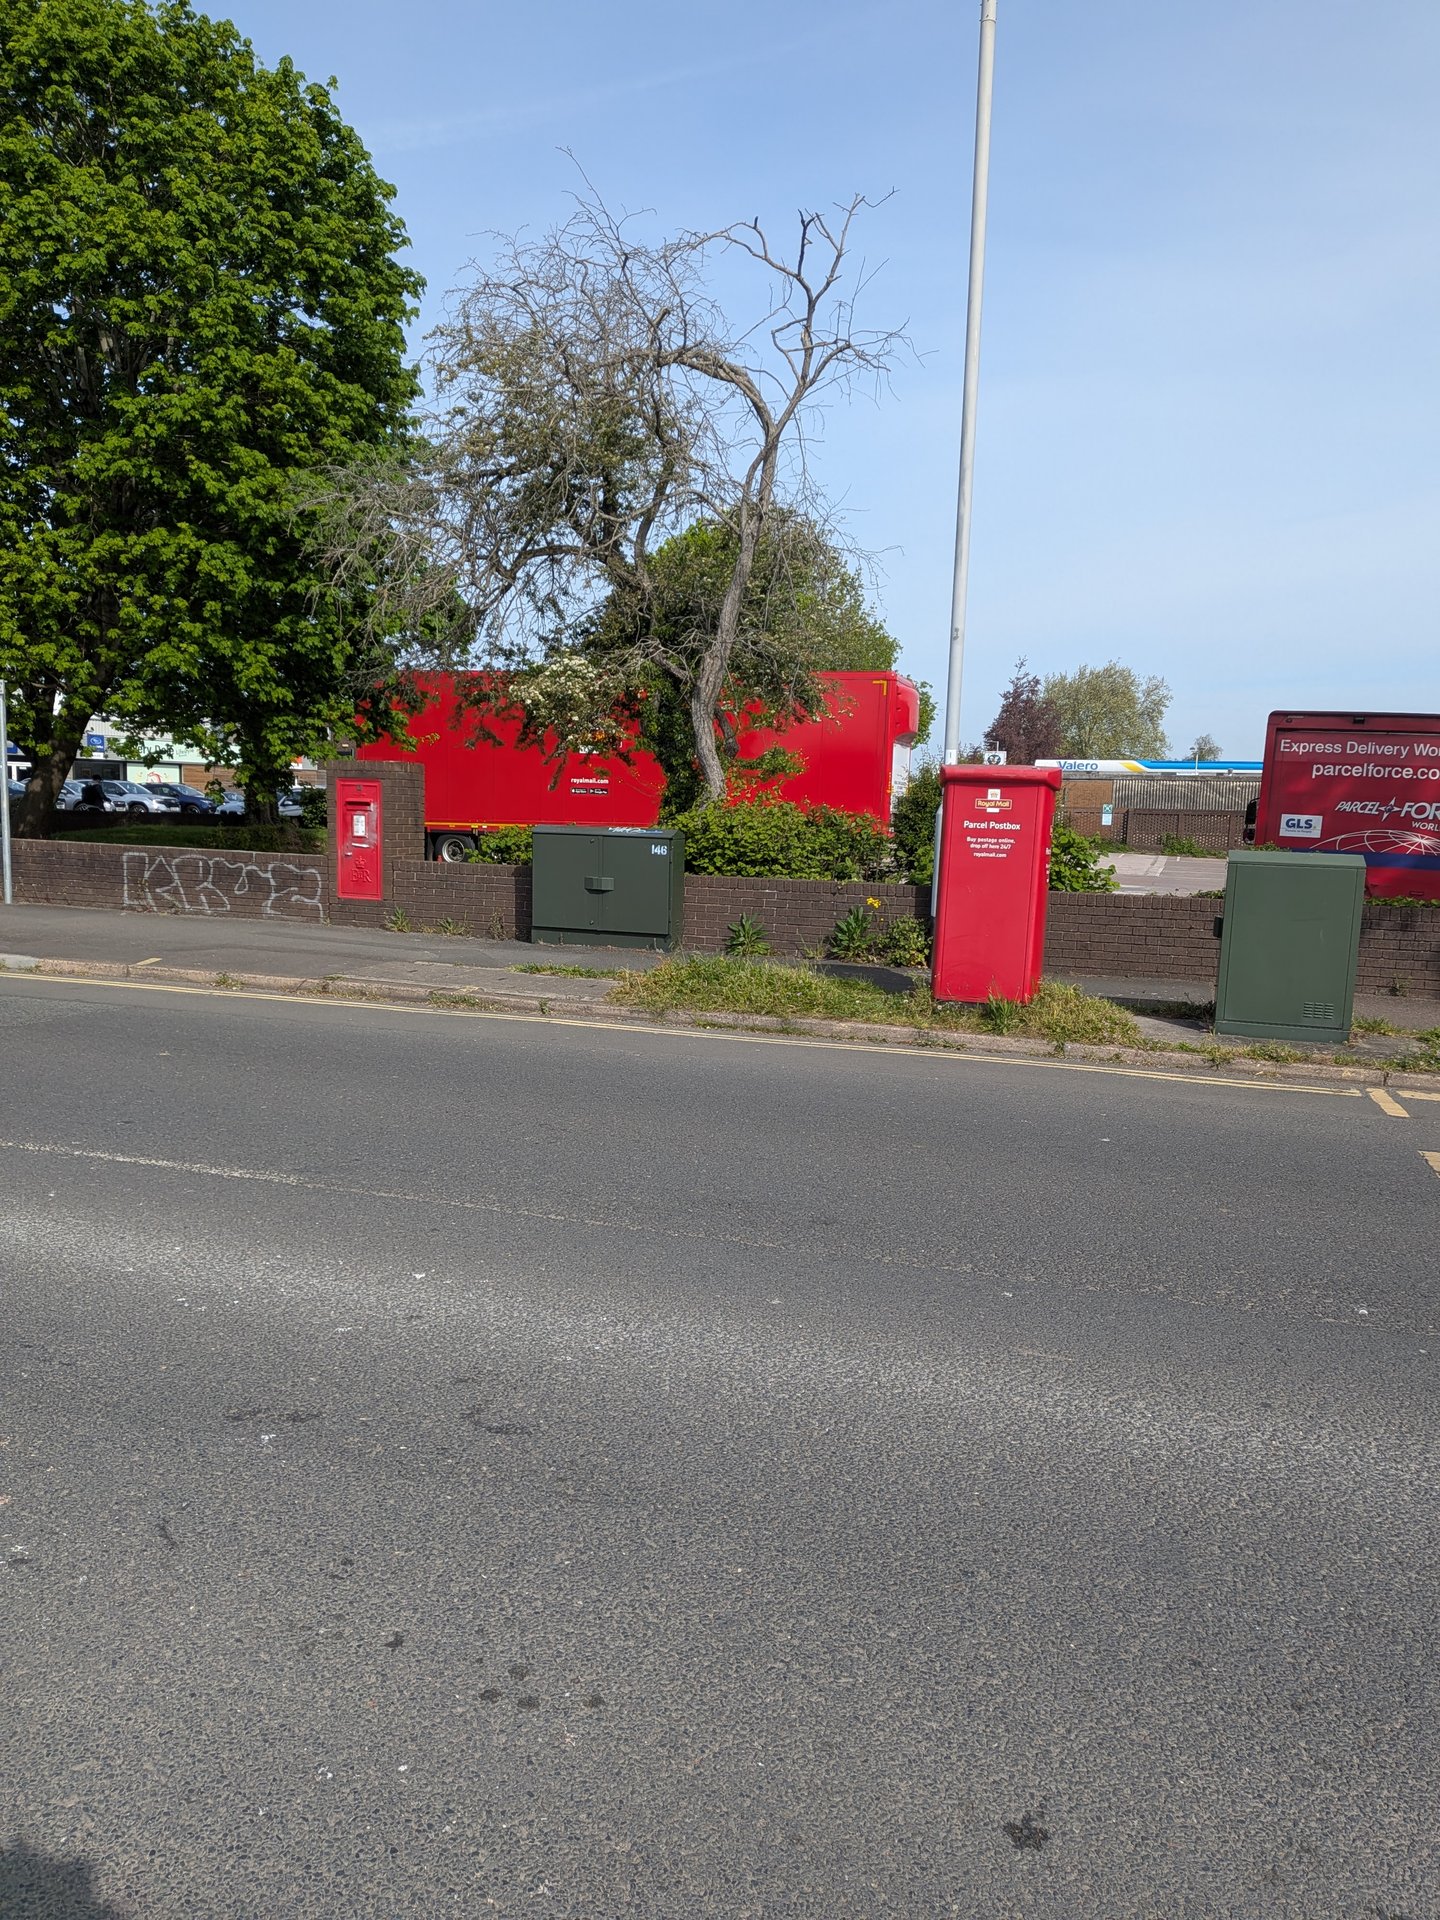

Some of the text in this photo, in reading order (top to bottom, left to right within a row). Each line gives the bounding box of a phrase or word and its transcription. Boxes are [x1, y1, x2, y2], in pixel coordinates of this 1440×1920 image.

[1280, 739, 1342, 755] Express
[1346, 741, 1409, 758] Delivery
[1058, 761, 1098, 771] Valero
[1312, 763, 1440, 780] parcelforce.co
[977, 800, 995, 808] Royal
[1335, 801, 1380, 815] PARCEL
[963, 820, 1021, 830] Parcel Postbox
